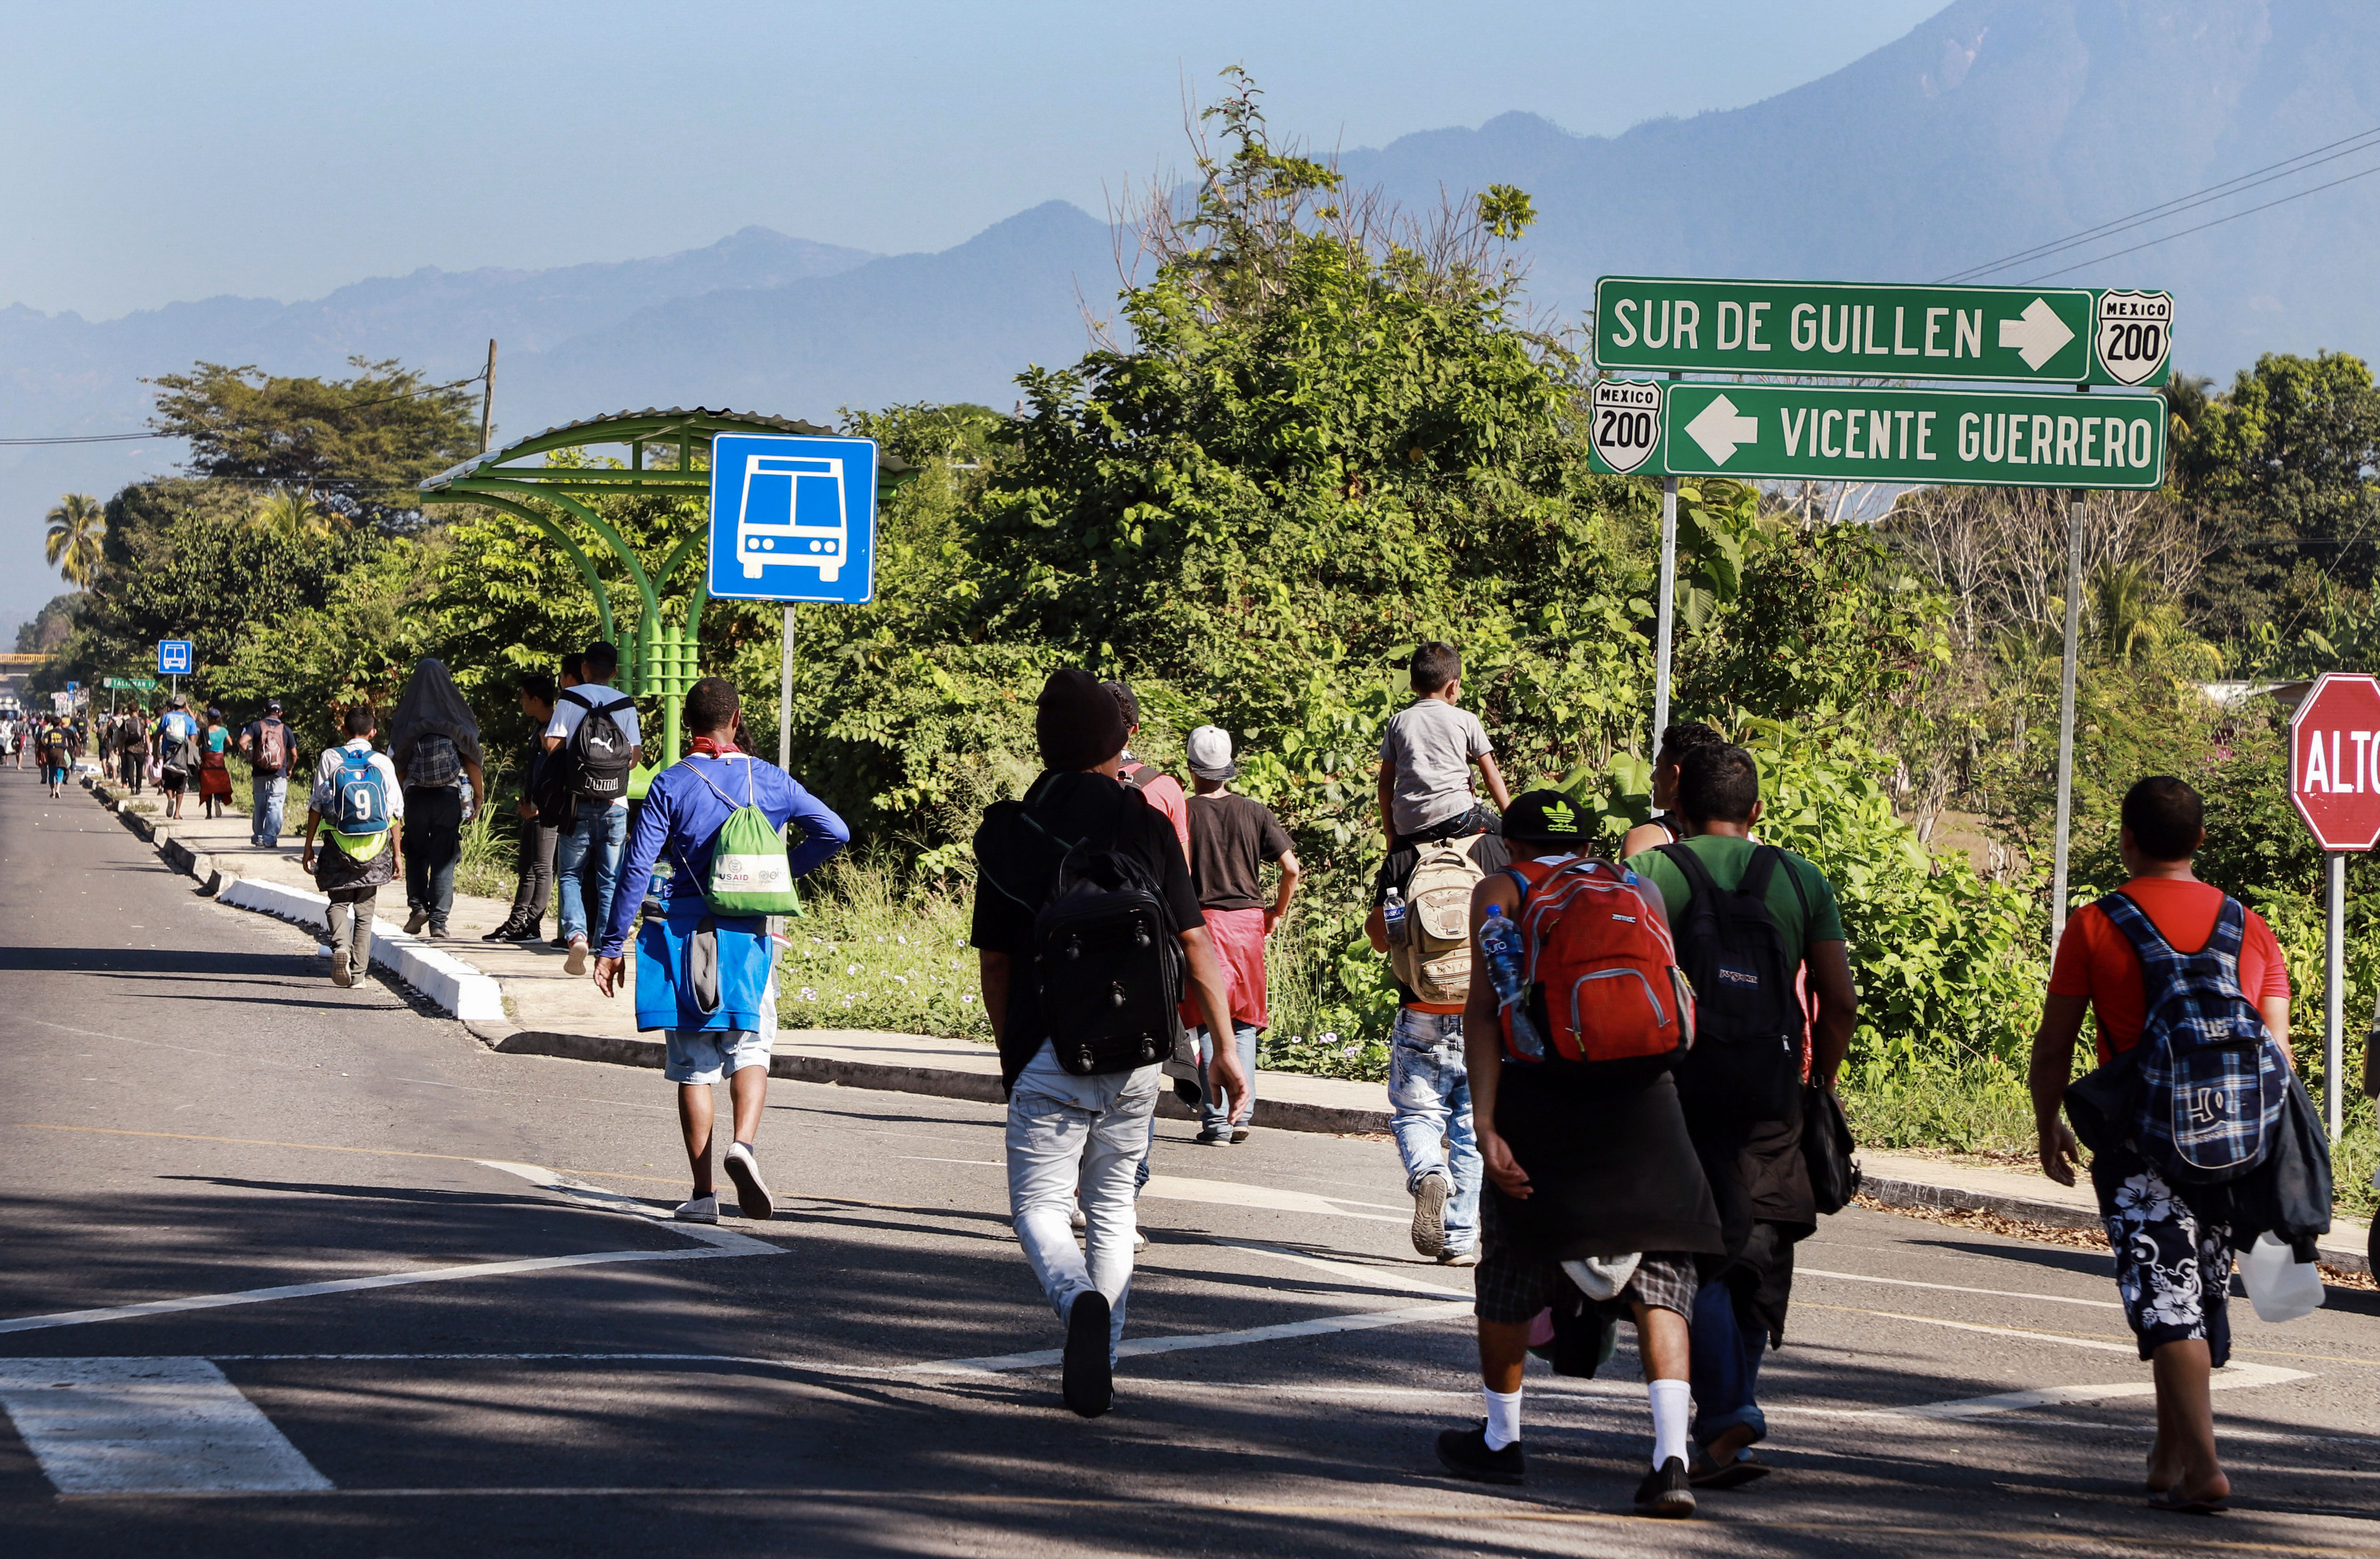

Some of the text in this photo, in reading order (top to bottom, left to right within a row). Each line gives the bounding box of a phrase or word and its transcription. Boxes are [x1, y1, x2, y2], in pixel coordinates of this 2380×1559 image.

[2106, 303, 2166, 316] MEXICO
[1612, 298, 1982, 358] SUR DE GUILLEN
[2107, 323, 2160, 361] 200
[1600, 388, 1654, 404] MEXICO
[1599, 410, 1651, 448] 200
[1780, 407, 2152, 468] VICENTE GUERRERO
[585, 777, 618, 791] PUMA
[355, 789, 371, 820] 9
[1548, 822, 1578, 833] adidas
